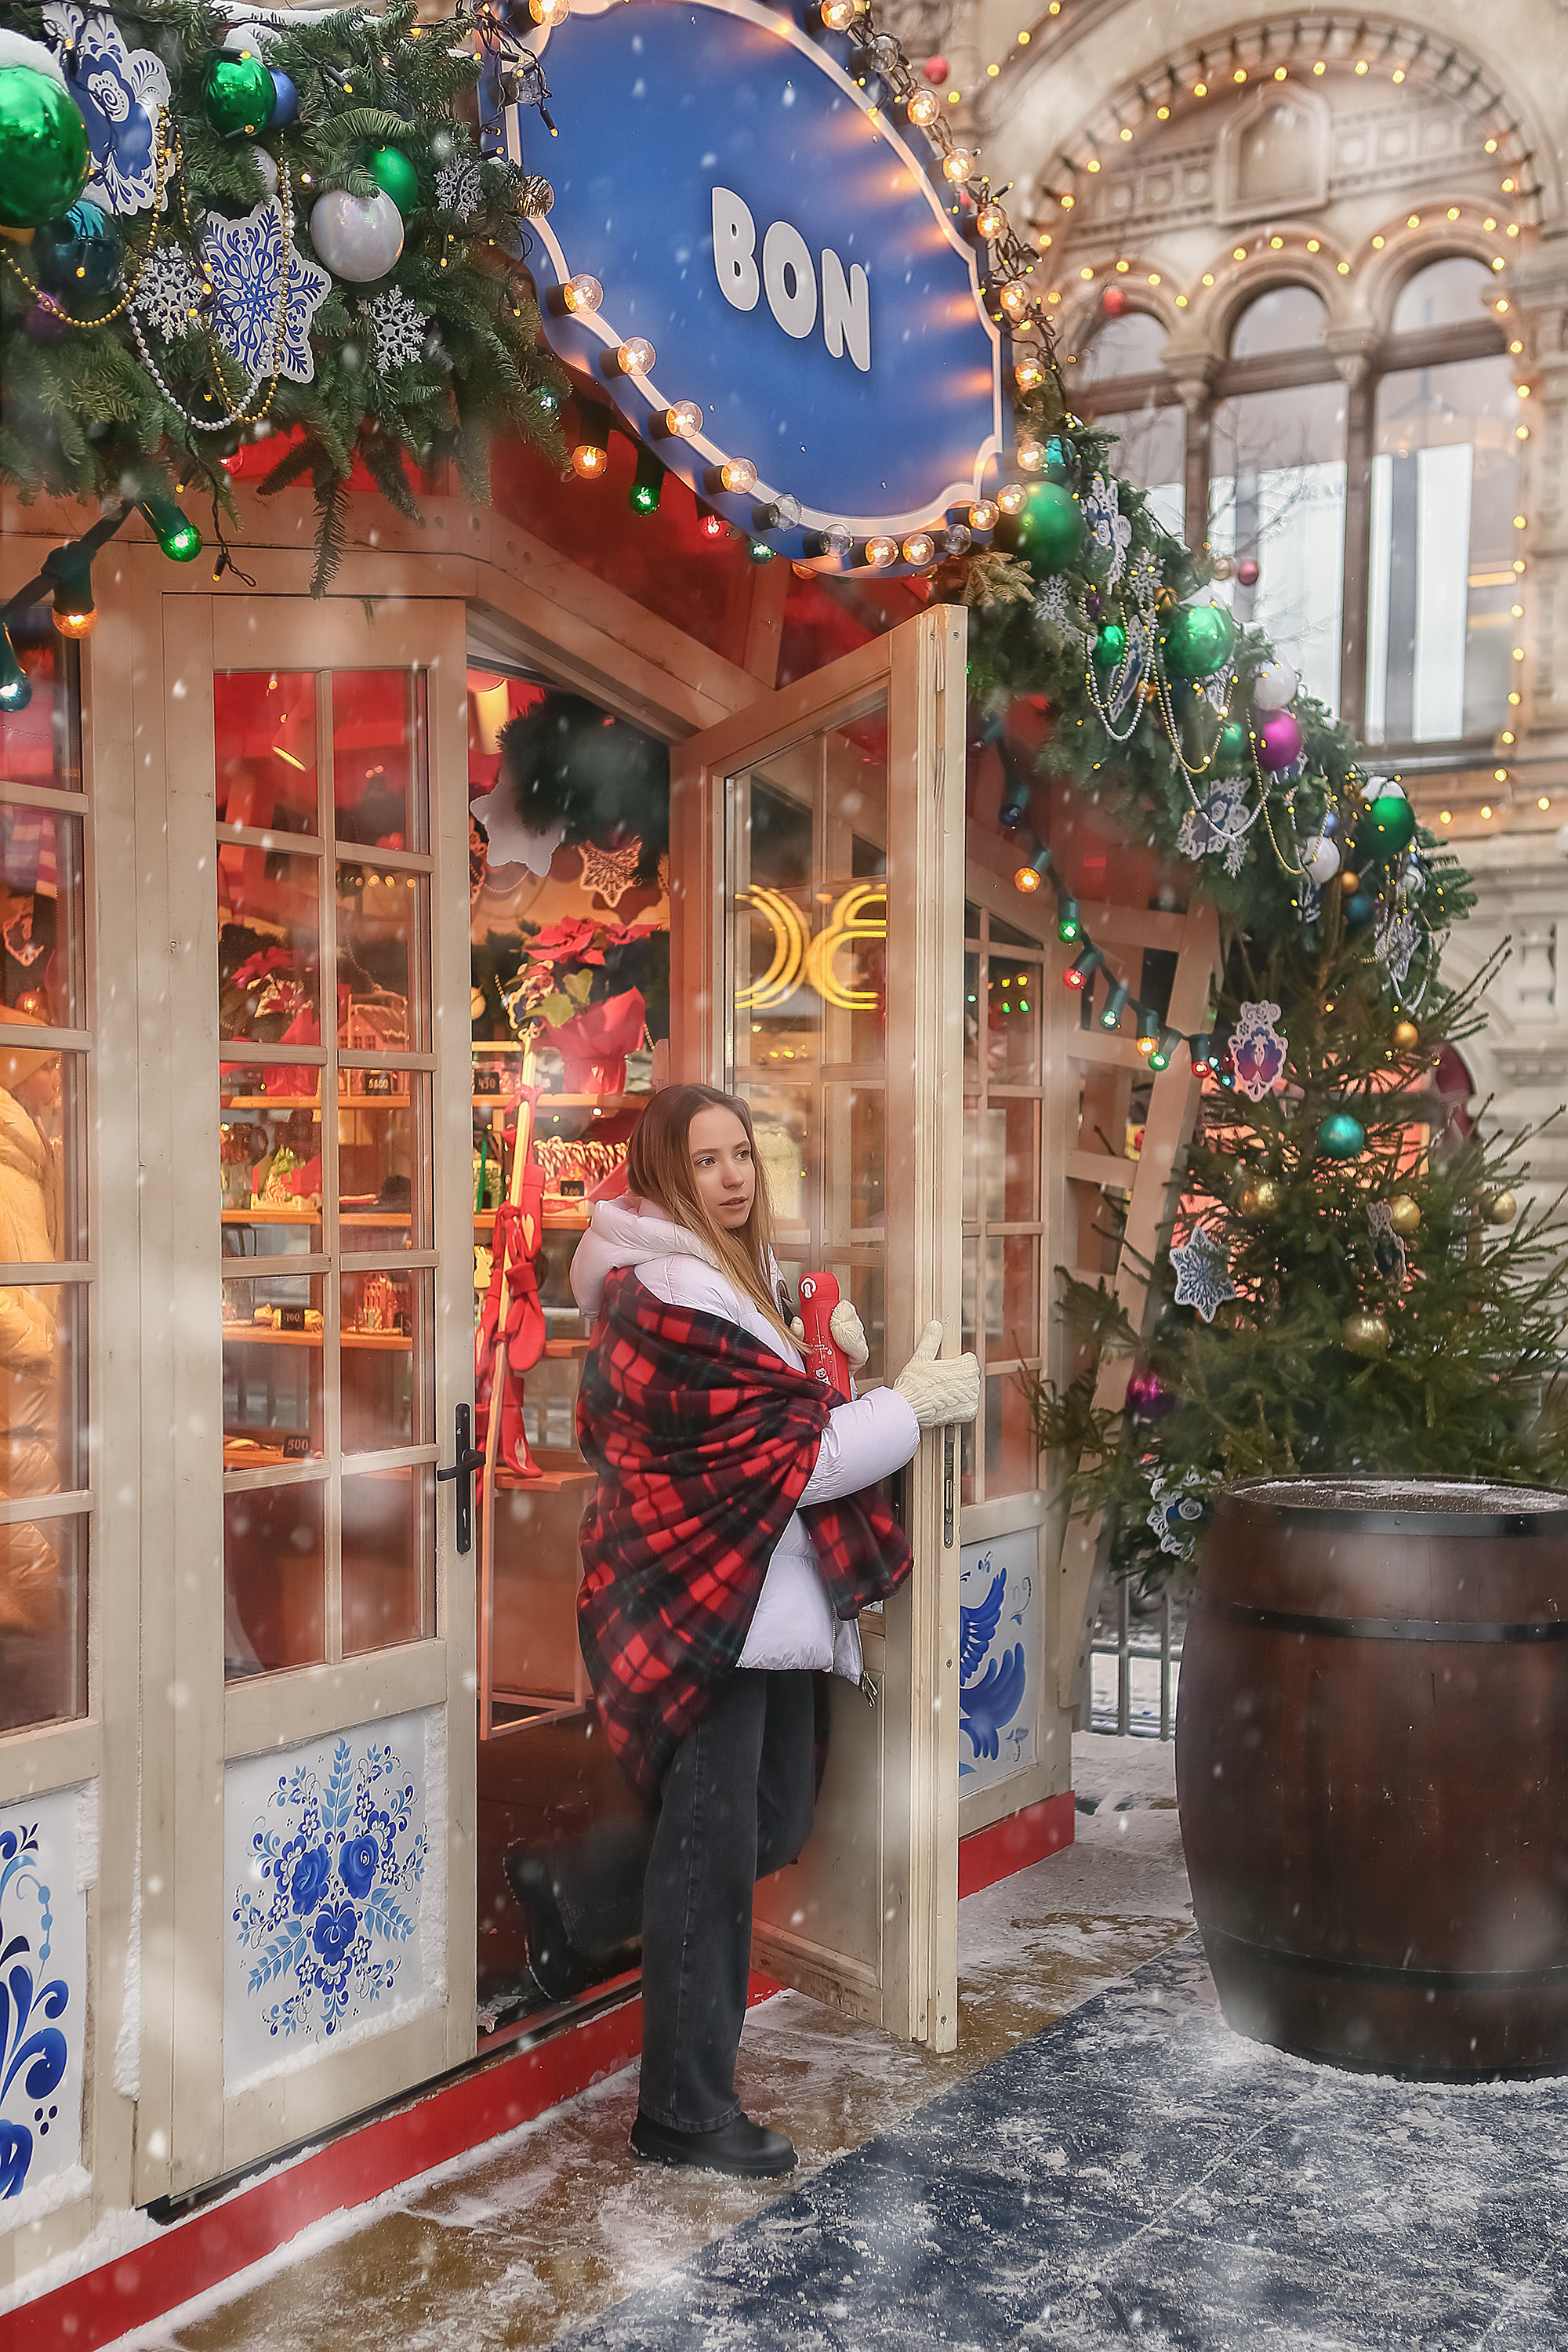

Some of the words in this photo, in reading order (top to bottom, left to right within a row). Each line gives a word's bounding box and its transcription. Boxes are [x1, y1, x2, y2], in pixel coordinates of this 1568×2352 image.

[712, 186, 871, 372] BON
[478, 1076, 495, 1089] 450
[288, 1438, 309, 1451] 500
